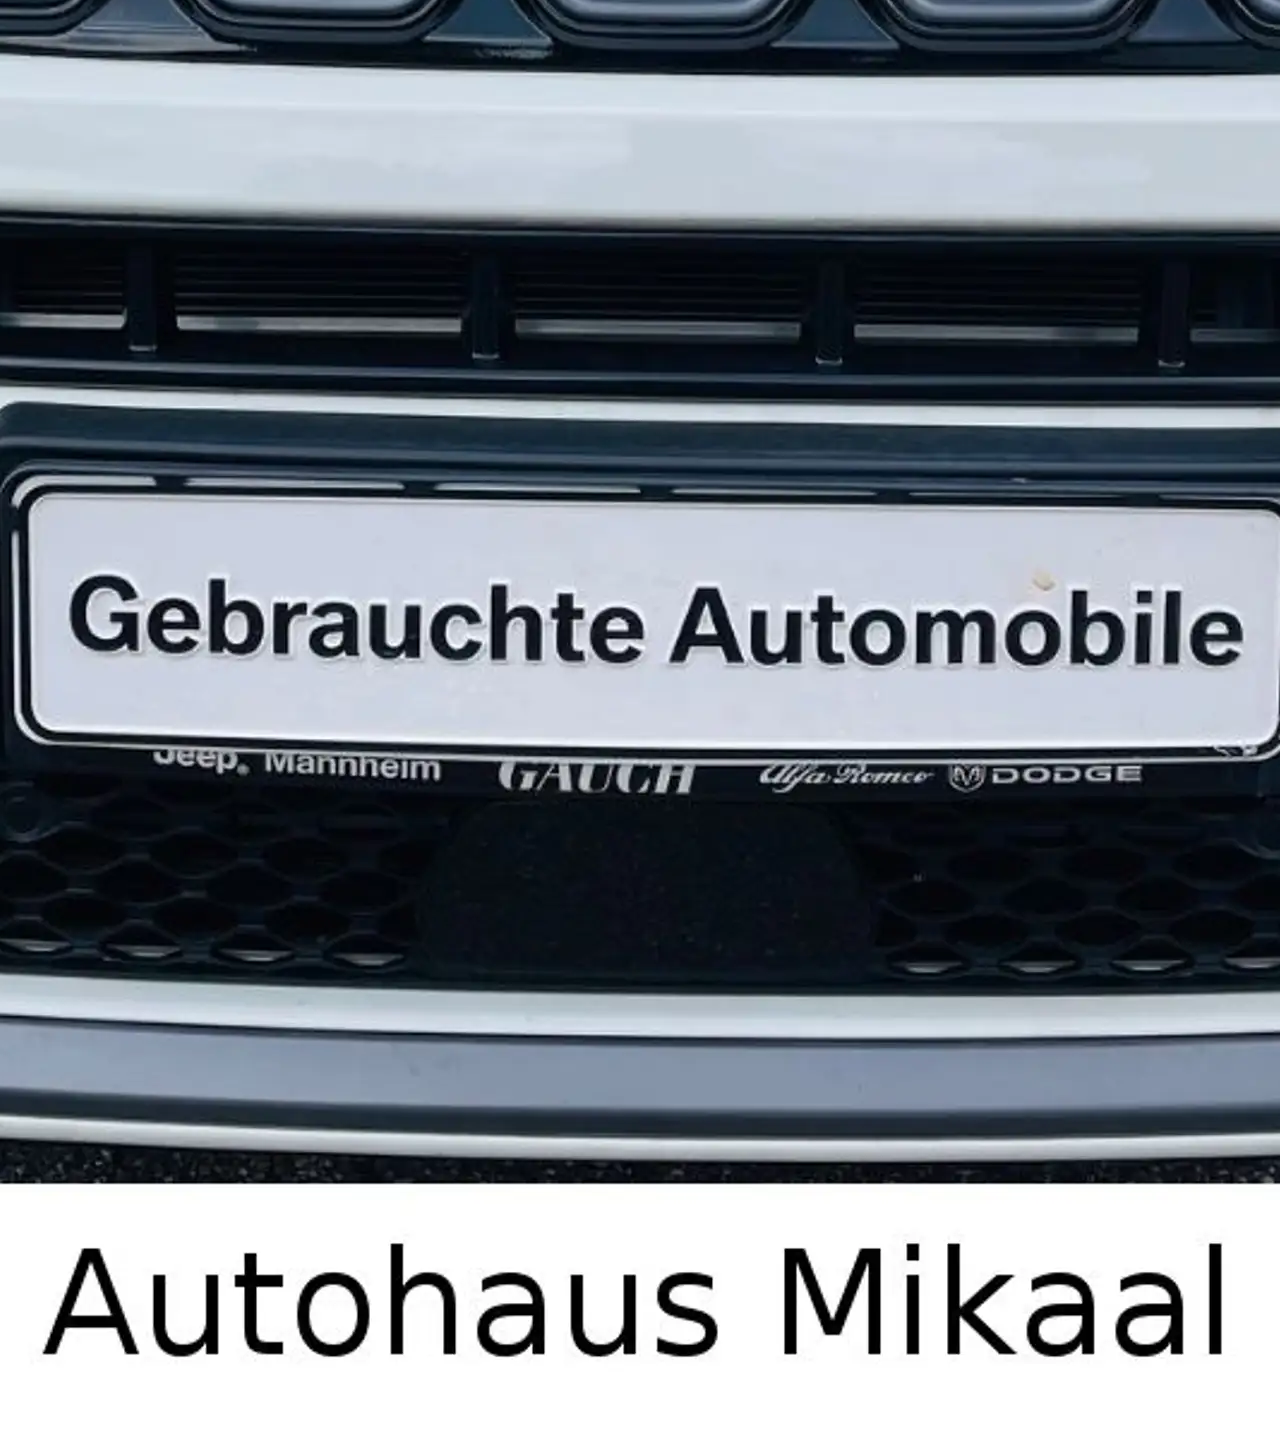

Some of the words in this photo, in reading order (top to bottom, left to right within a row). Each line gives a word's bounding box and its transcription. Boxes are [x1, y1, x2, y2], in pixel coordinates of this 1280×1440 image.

[69, 575, 644, 663] Gebrauchte
[669, 587, 1243, 666] Automobile
[264, 753, 442, 782] Mannheim
[498, 760, 697, 795] GAUCH
[759, 761, 831, 794] Alfa
[991, 764, 1144, 785] DODGE
